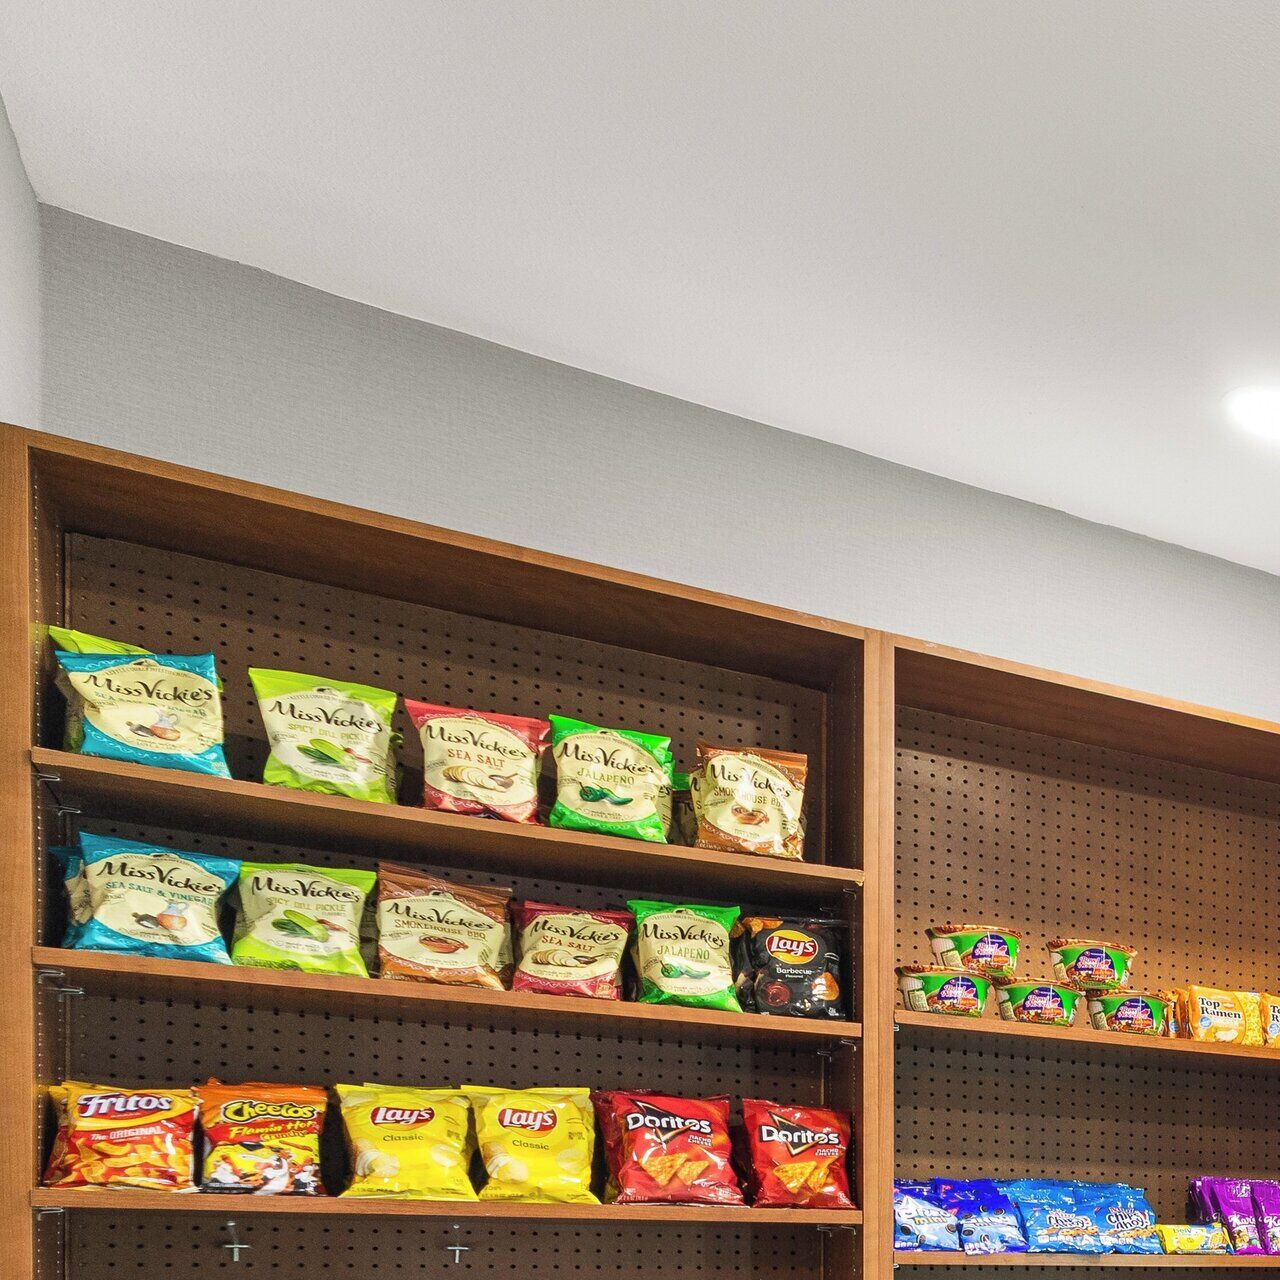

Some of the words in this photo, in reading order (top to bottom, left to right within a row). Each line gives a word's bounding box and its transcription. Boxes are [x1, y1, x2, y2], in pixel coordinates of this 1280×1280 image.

[447, 747, 473, 764] SEA
[476, 754, 505, 769] SALT
[105, 881, 126, 892] SEA
[129, 883, 154, 895] SALT
[315, 902, 347, 914] PICKLE
[394, 919, 463, 939] SMOKEHOUSE
[466, 930, 487, 942] BBQ
[541, 935, 565, 947] SEA
[568, 940, 595, 953] SALT
[776, 966, 813, 977] Barbecue
[1199, 997, 1220, 1010] Top
[1201, 1007, 1242, 1019] Ramen
[77, 1092, 172, 1118] Fritos
[221, 1100, 317, 1122] Cheetos
[373, 1105, 434, 1126] Lay's
[502, 1107, 555, 1131] Lay's
[626, 1113, 712, 1135] Doritos
[109, 1125, 164, 1141] ORIGINAL
[383, 1133, 424, 1143] Classic
[761, 1125, 840, 1145] Doritos
[512, 1139, 550, 1151] Classic
